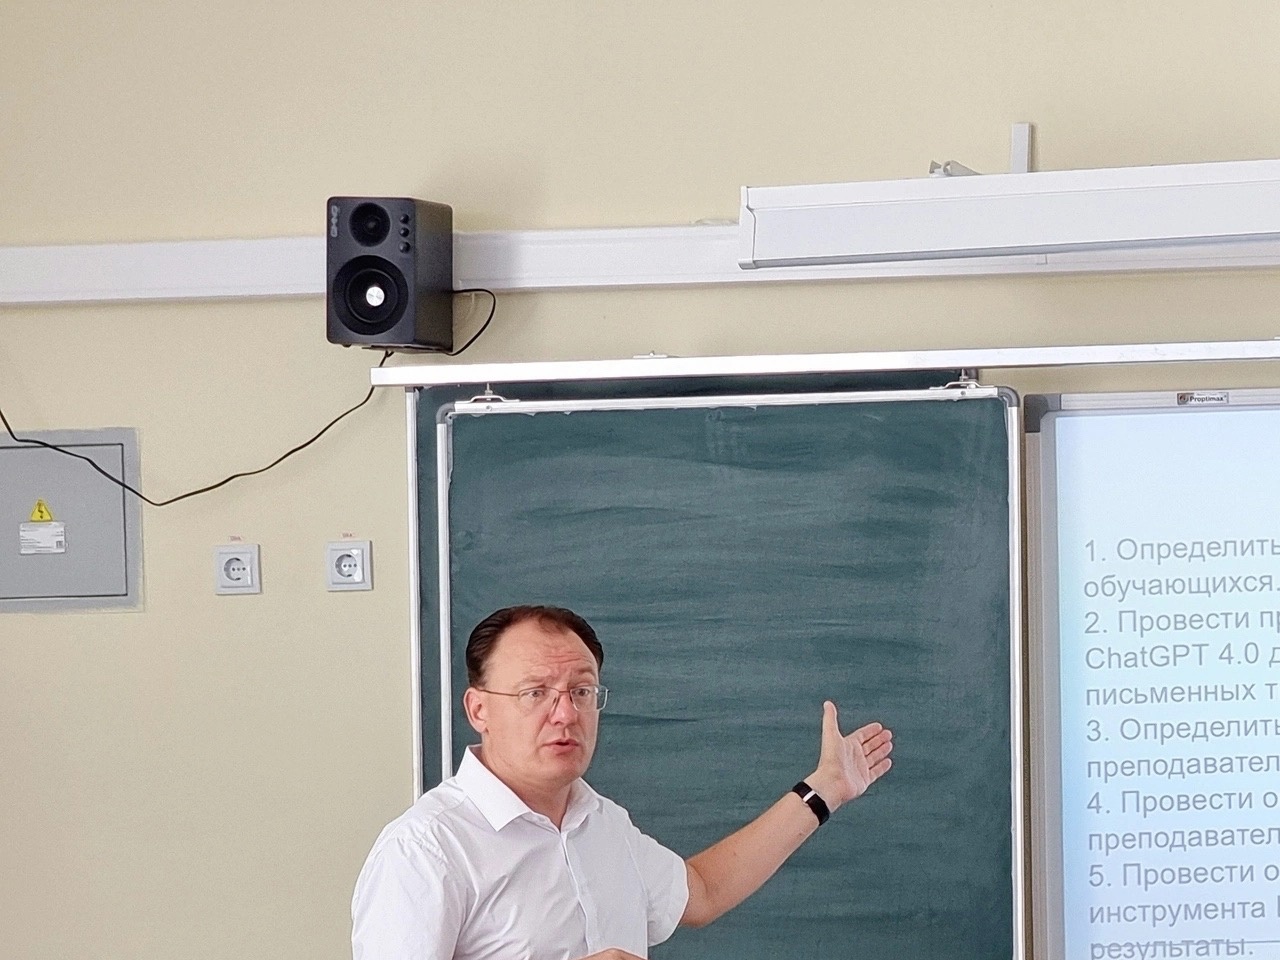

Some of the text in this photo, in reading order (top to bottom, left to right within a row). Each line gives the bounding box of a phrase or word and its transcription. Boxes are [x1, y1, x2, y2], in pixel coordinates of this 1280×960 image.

[1085, 539, 1107, 562] 1.
[1083, 573, 1280, 604] обучающихся.
[1084, 611, 1108, 634] 2.
[1118, 609, 1250, 639] Провести
[1085, 642, 1210, 670] ChatGPT
[1218, 641, 1260, 665] 4.0
[1086, 683, 1257, 706] письменных
[1086, 719, 1110, 742] 3.
[1086, 791, 1111, 815] 4.
[1121, 789, 1253, 819] Провести
[1088, 863, 1112, 888] 5.
[1122, 862, 1255, 893] Провести
[1089, 901, 1266, 928] инструмента
